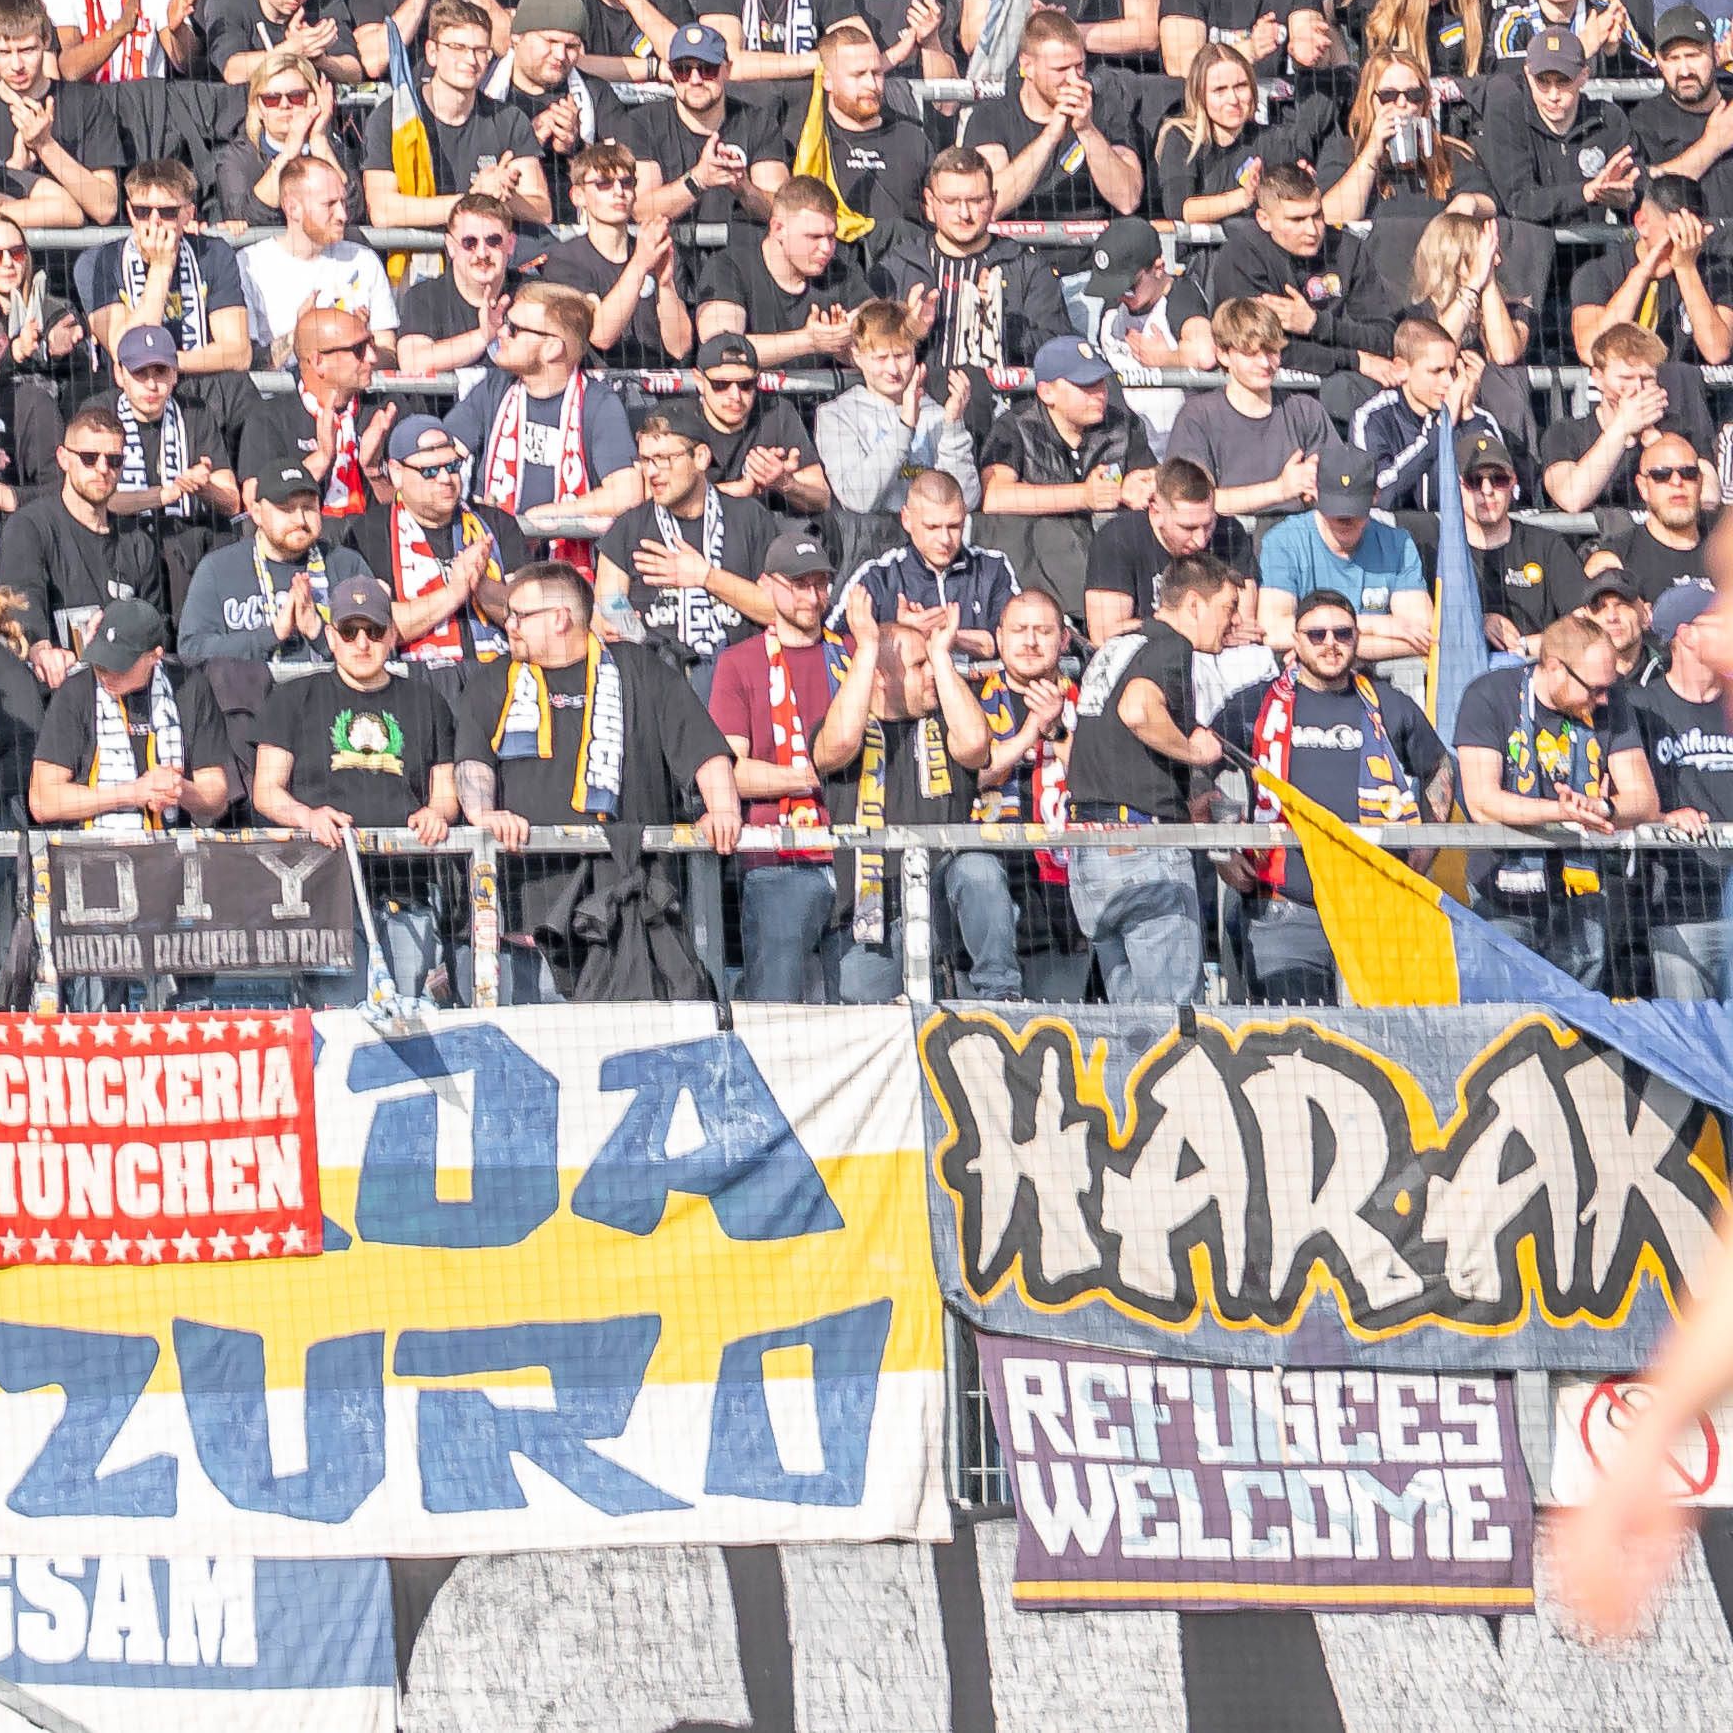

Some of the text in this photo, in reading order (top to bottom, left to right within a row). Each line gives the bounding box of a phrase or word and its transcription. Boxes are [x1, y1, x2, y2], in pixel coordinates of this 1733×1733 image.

[57, 843, 336, 926] DIY
[1002, 1357, 1502, 1463] REFUGEES
[1014, 1461, 1513, 1562] WELCOME
